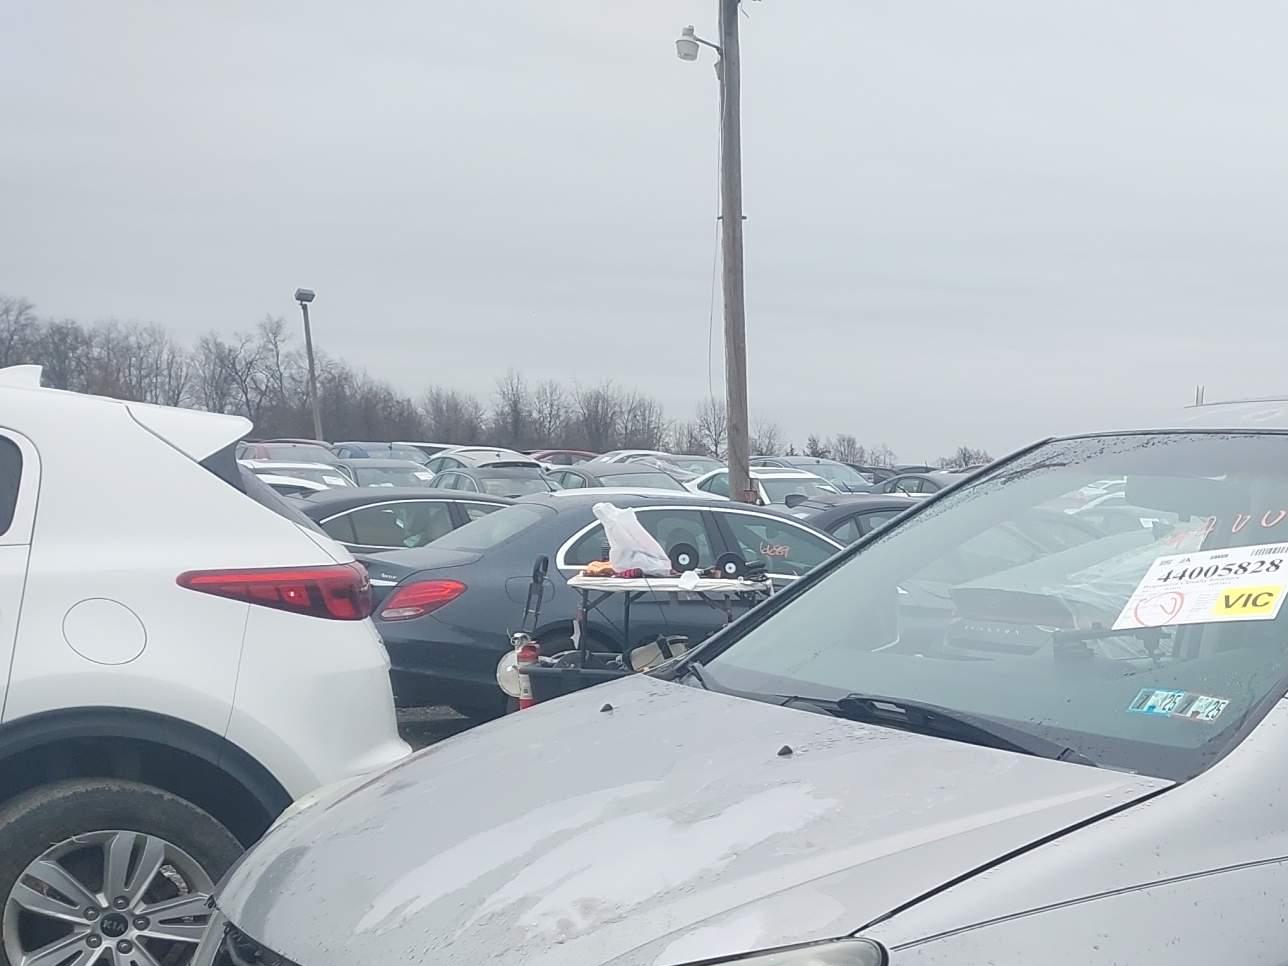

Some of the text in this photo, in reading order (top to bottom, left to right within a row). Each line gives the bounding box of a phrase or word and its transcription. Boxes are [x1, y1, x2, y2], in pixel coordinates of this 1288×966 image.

[1158, 559, 1284, 583] 44005828
[1223, 592, 1275, 609] VIC
[102, 919, 125, 931] KIA
